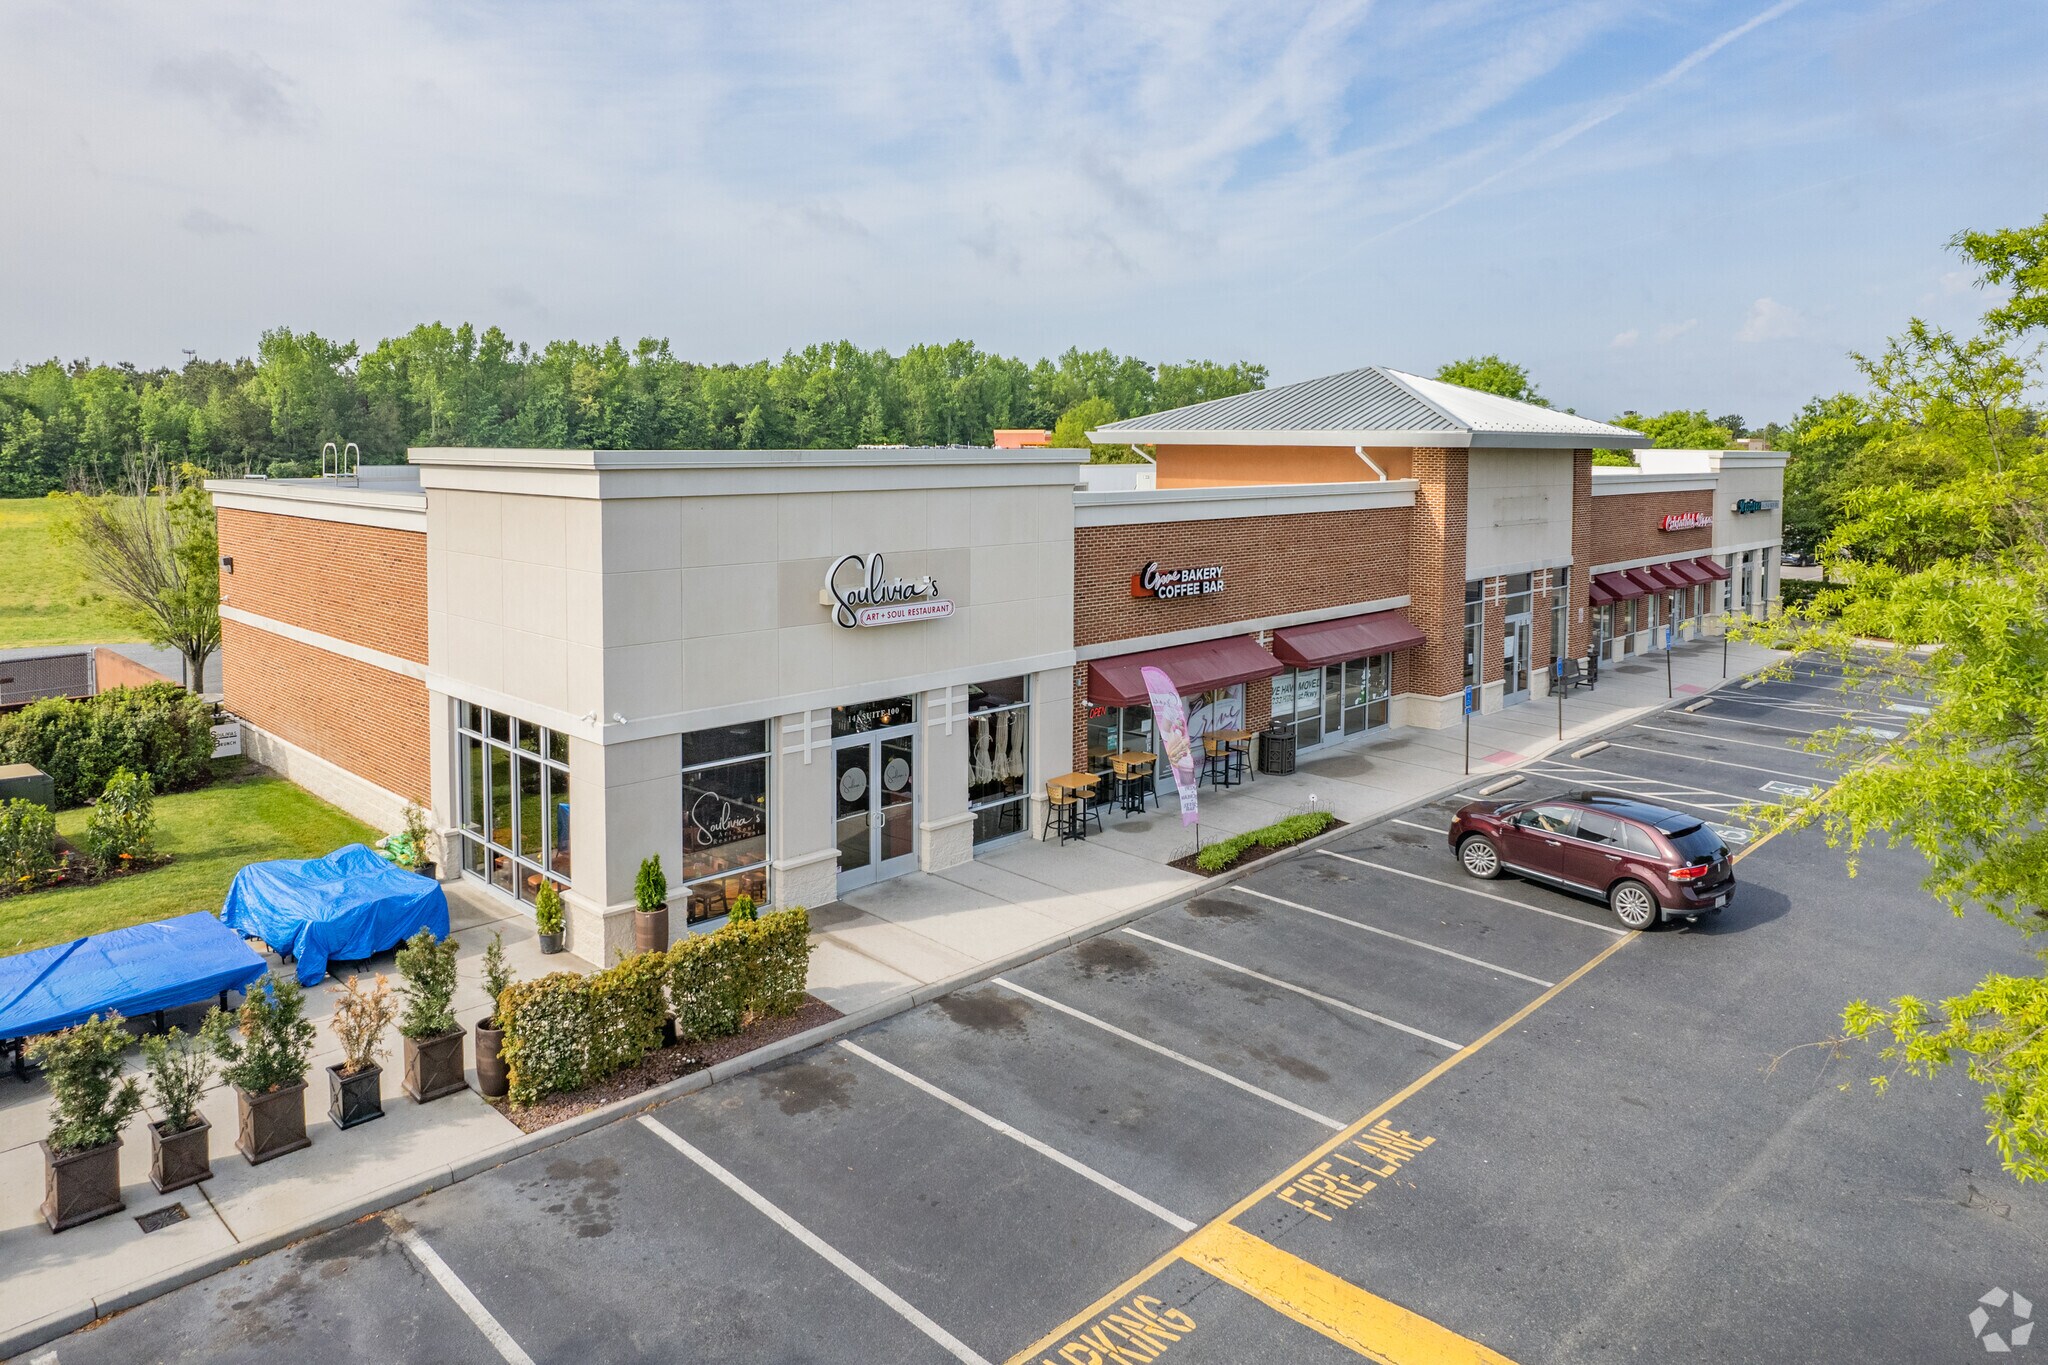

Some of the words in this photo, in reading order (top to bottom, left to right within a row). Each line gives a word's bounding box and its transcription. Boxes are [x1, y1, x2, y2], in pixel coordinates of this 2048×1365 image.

[1181, 566, 1224, 582] BAKERY
[828, 552, 940, 629] Soulivia's
[1158, 582, 1201, 599] COFFEE
[1202, 580, 1225, 594] BAR
[866, 612, 880, 621] ART
[887, 609, 905, 619] SOUL
[908, 604, 950, 617] RESTAURANT
[861, 709, 886, 720] SUITE
[1089, 706, 1106, 719] OPEN
[1333, 1119, 1437, 1179] LANE
[1276, 1161, 1378, 1222] FIRE
